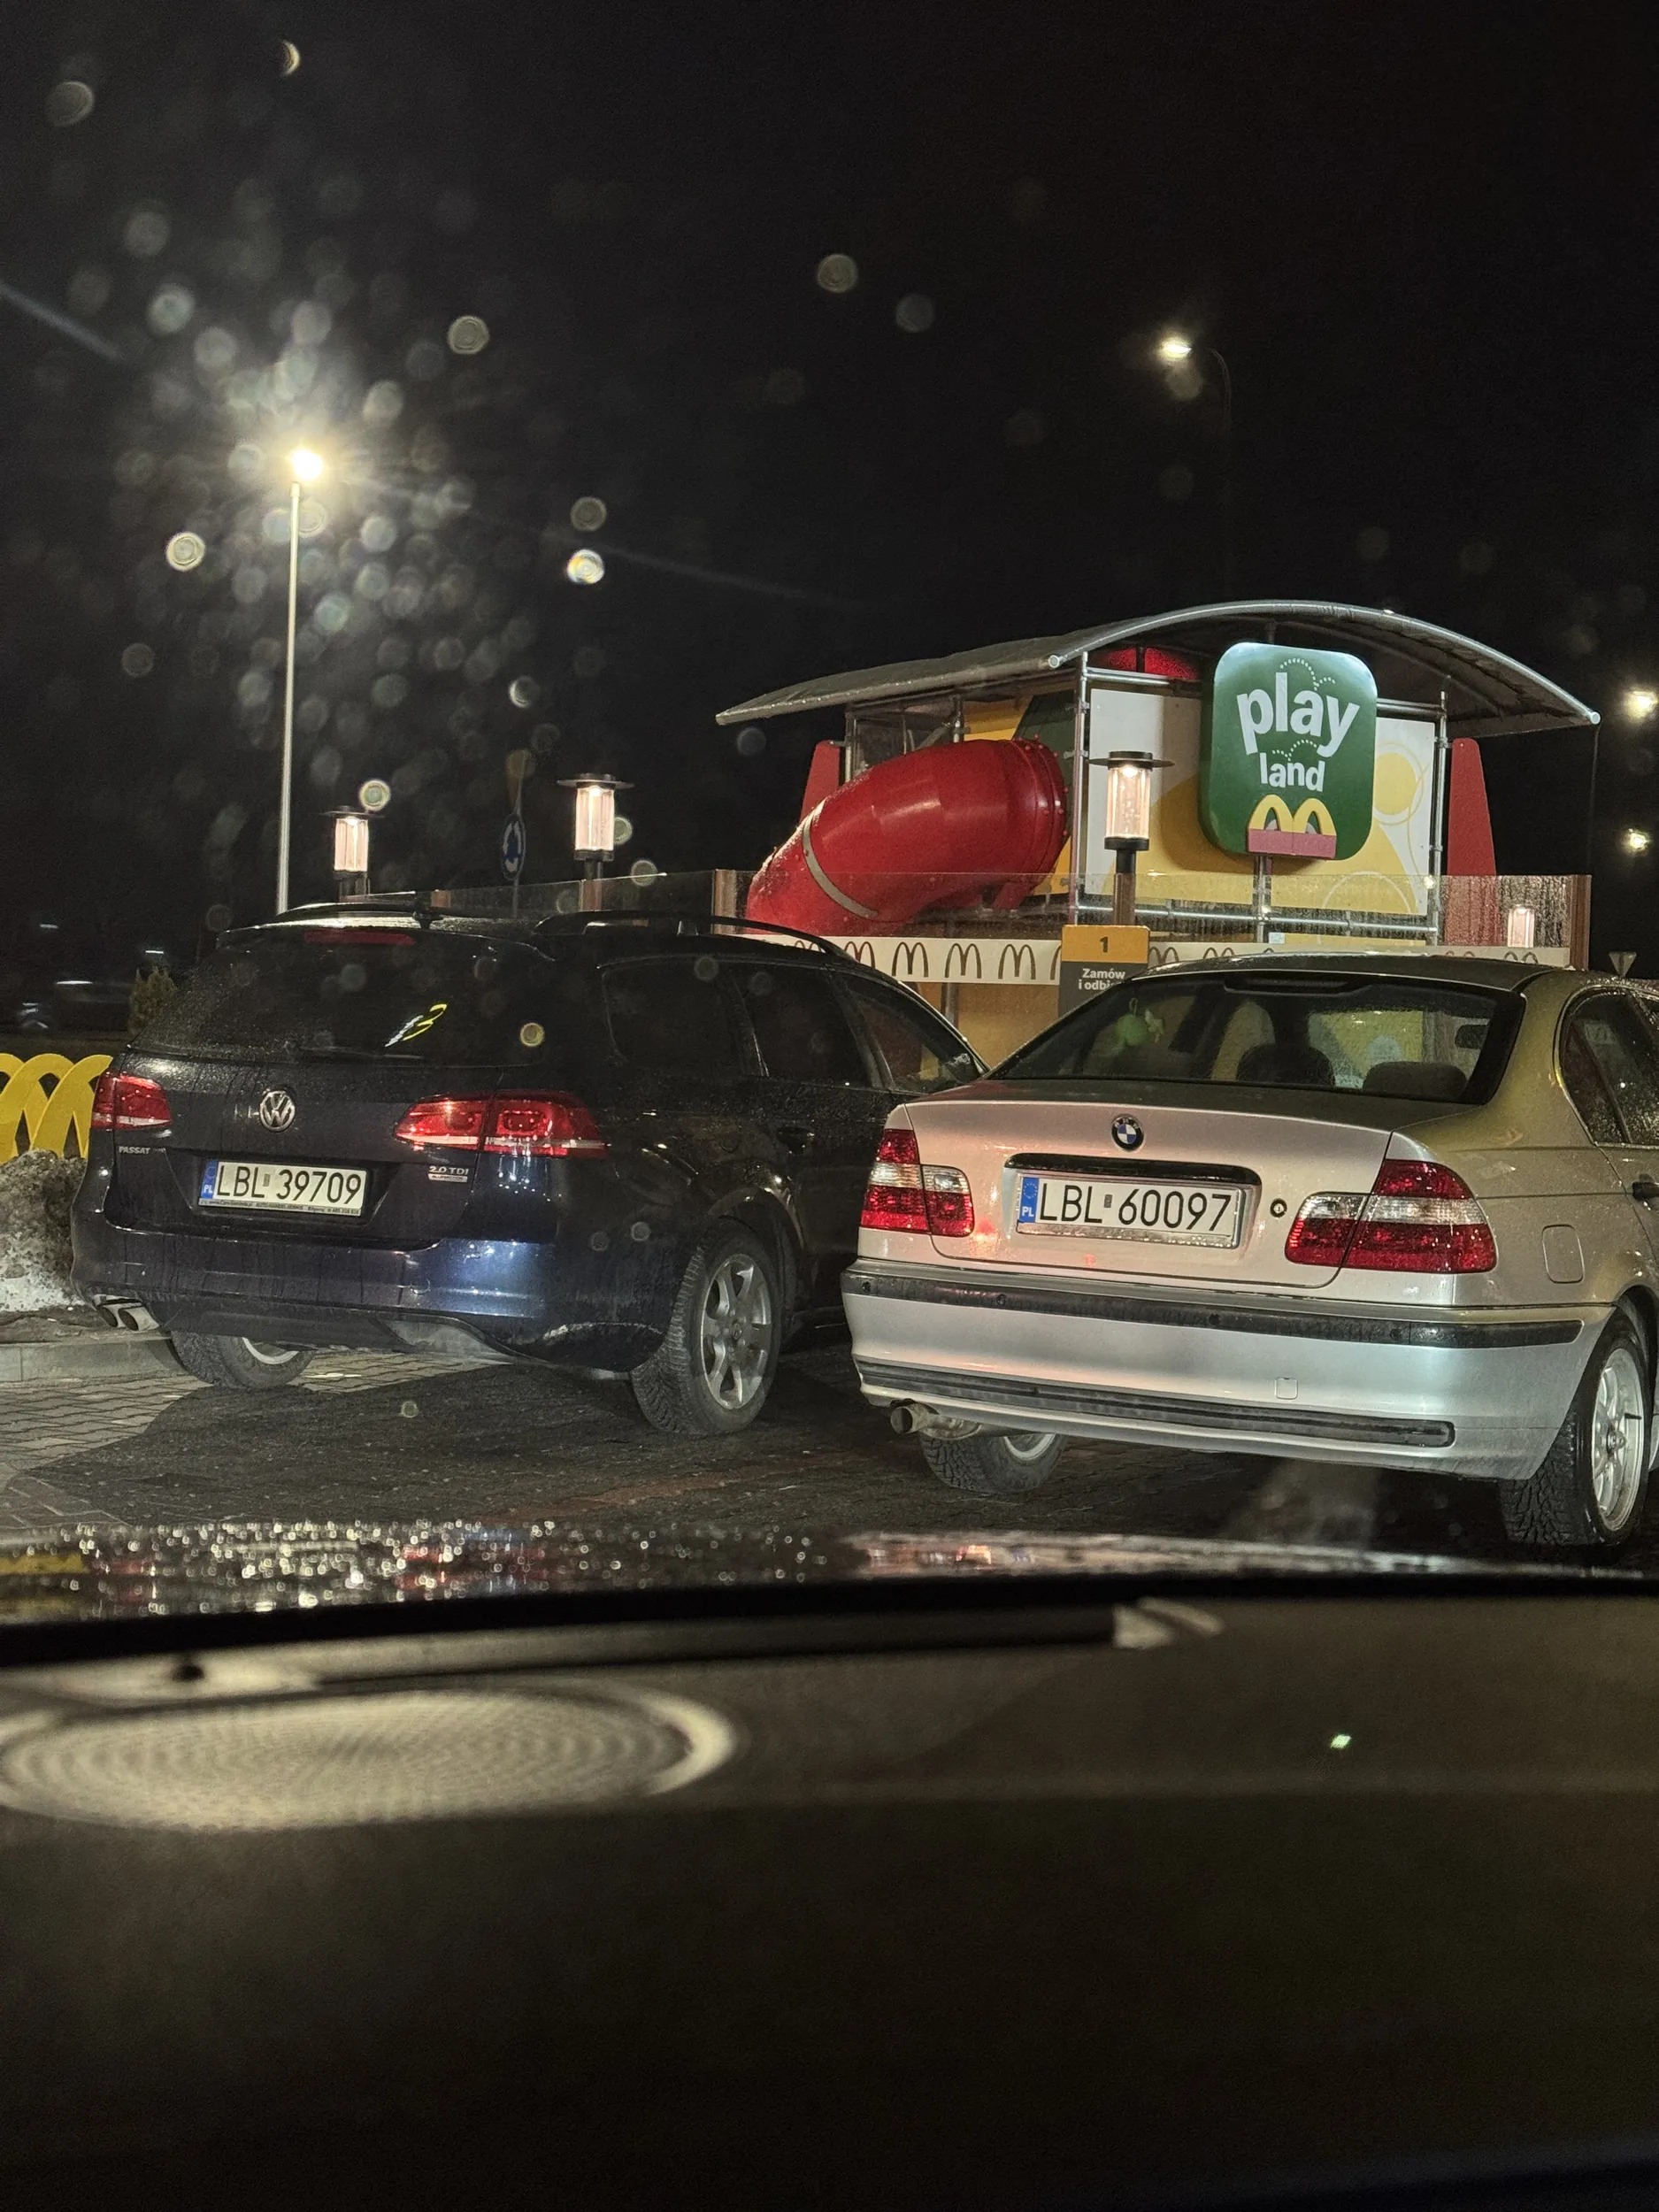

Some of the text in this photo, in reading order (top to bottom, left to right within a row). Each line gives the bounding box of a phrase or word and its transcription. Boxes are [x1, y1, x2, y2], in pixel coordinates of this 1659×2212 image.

[1236, 672, 1360, 757] play
[1260, 752, 1325, 792] land
[1100, 936, 1109, 953] 1
[1082, 968, 1125, 979] Zamów
[1079, 979, 1082, 989] i
[204, 1185, 213, 1194] PL
[217, 1164, 362, 1205] LBL 39709
[1021, 1205, 1034, 1217] PL
[1040, 1182, 1232, 1232] LBL 60097
